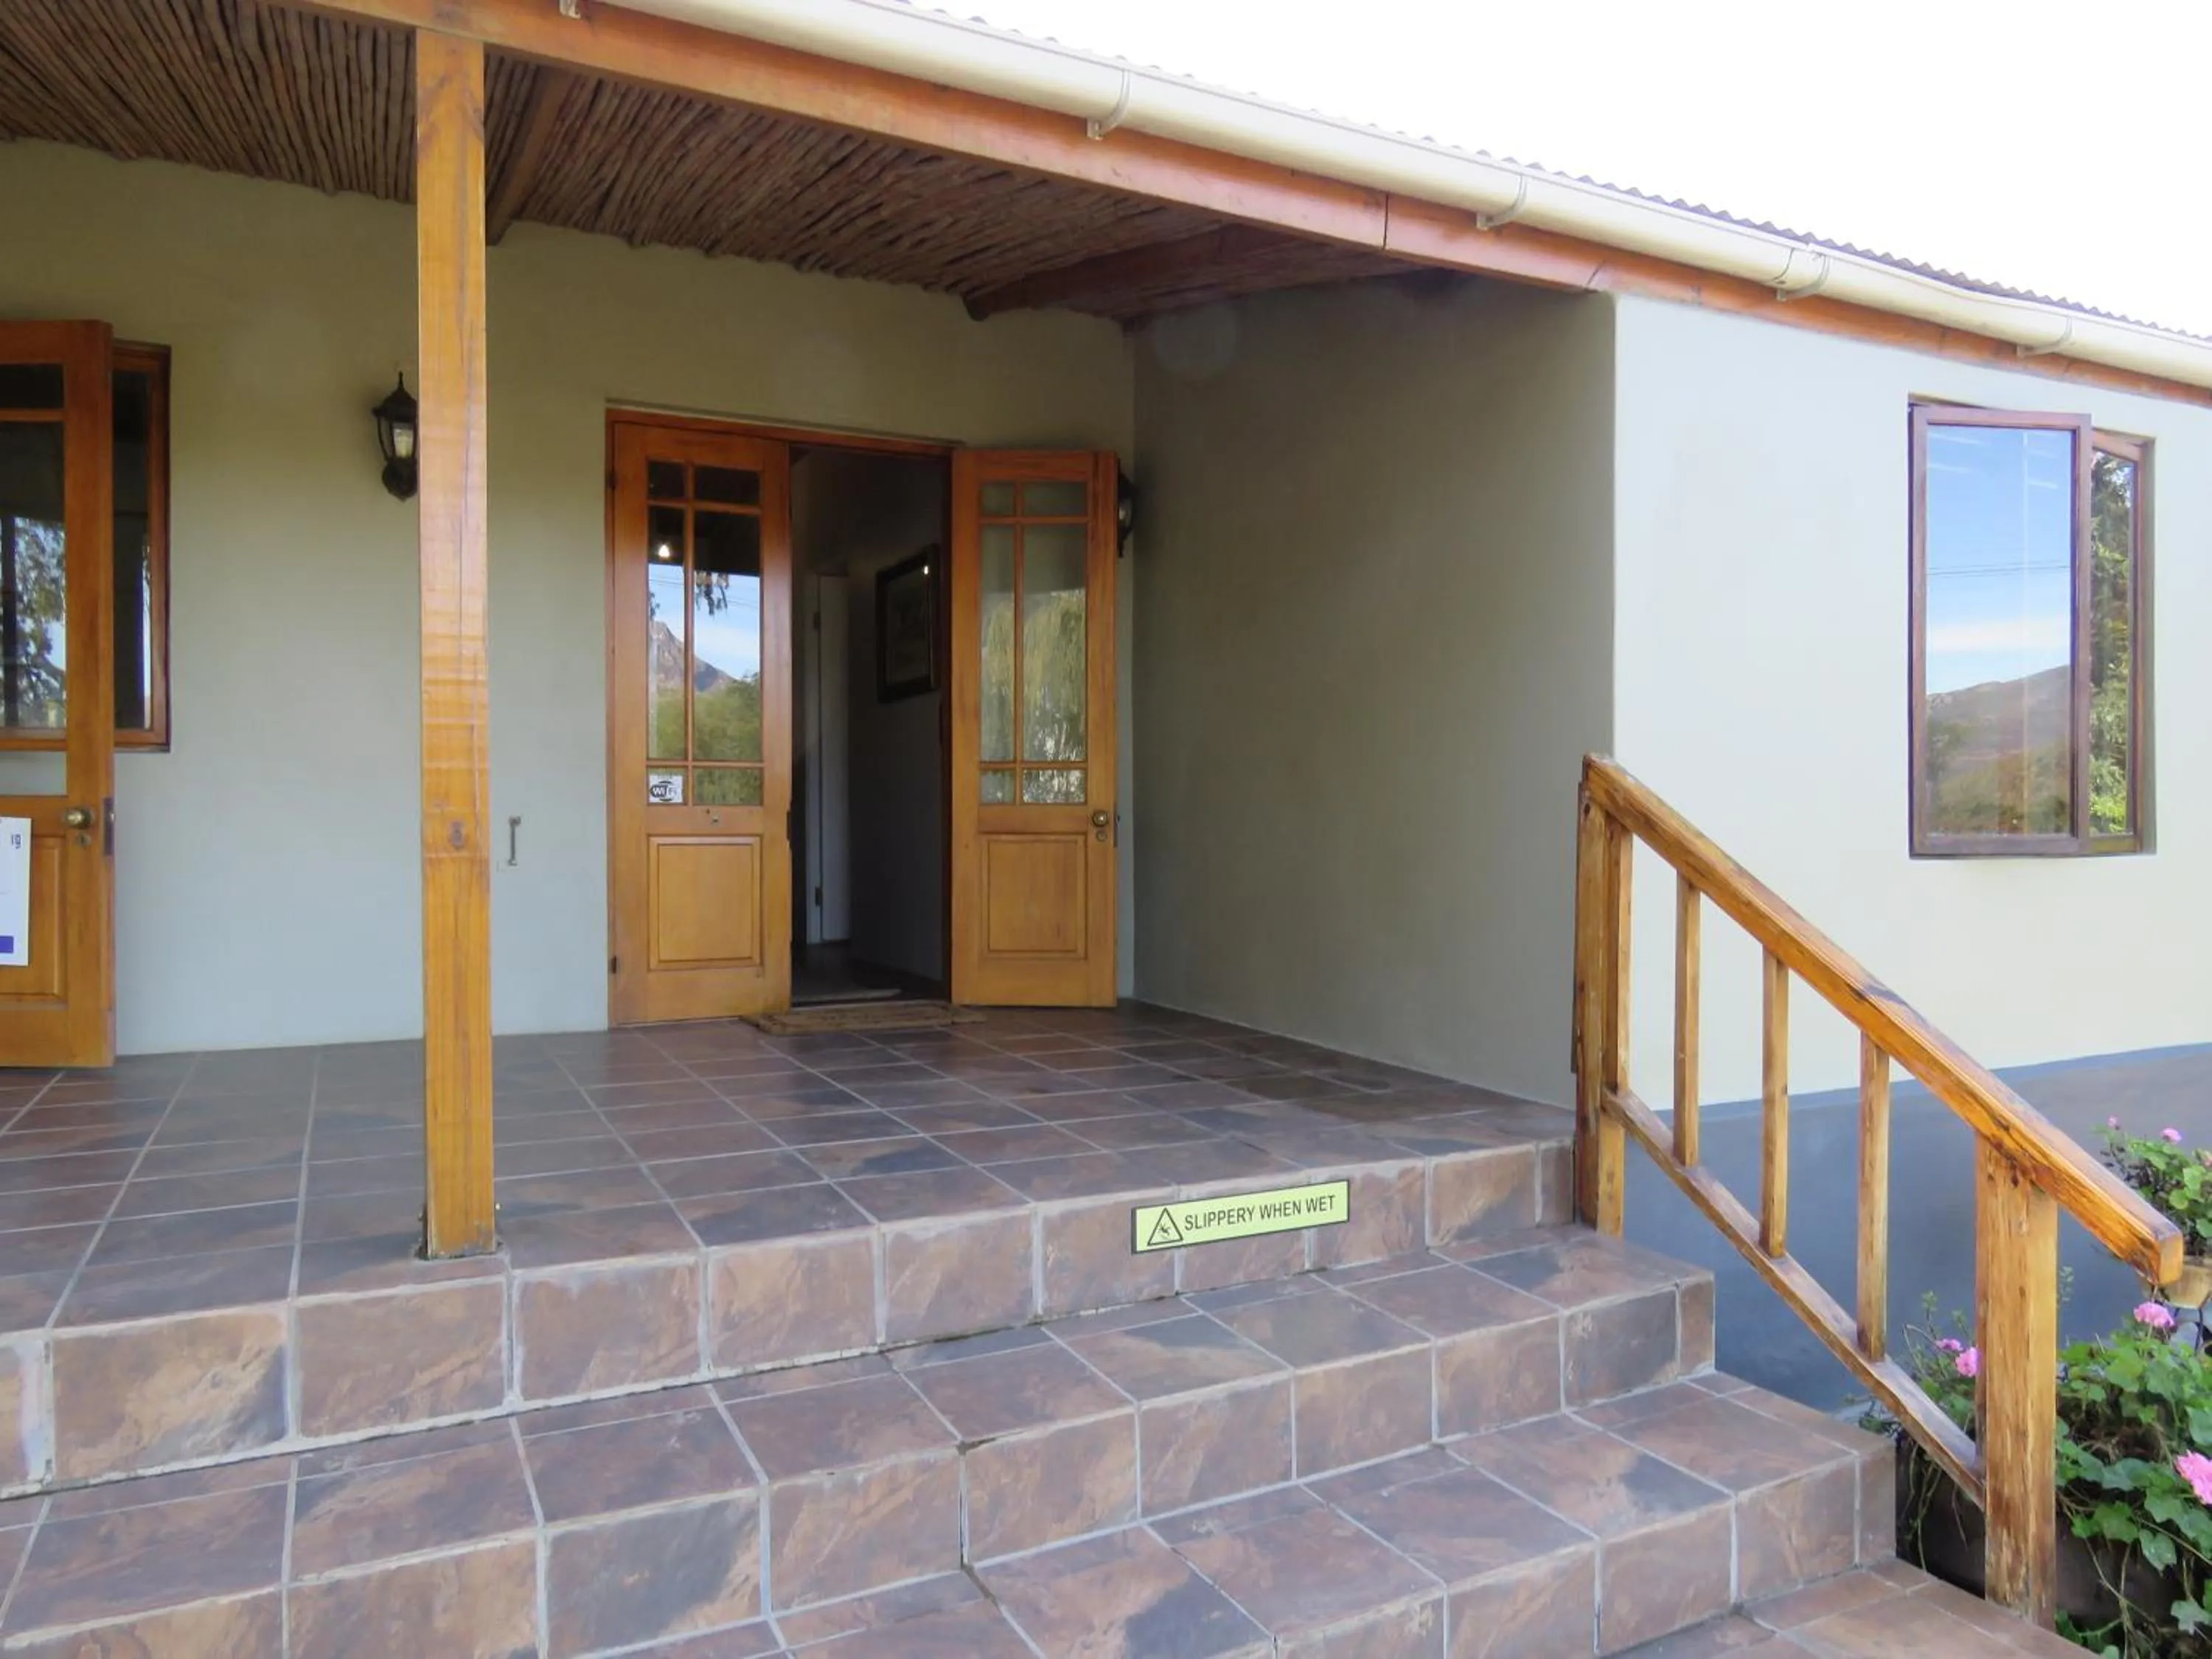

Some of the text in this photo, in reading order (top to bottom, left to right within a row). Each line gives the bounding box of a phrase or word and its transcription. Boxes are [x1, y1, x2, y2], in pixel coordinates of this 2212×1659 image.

[1184, 1194, 1336, 1231] SLIPPERY WHEN WET
